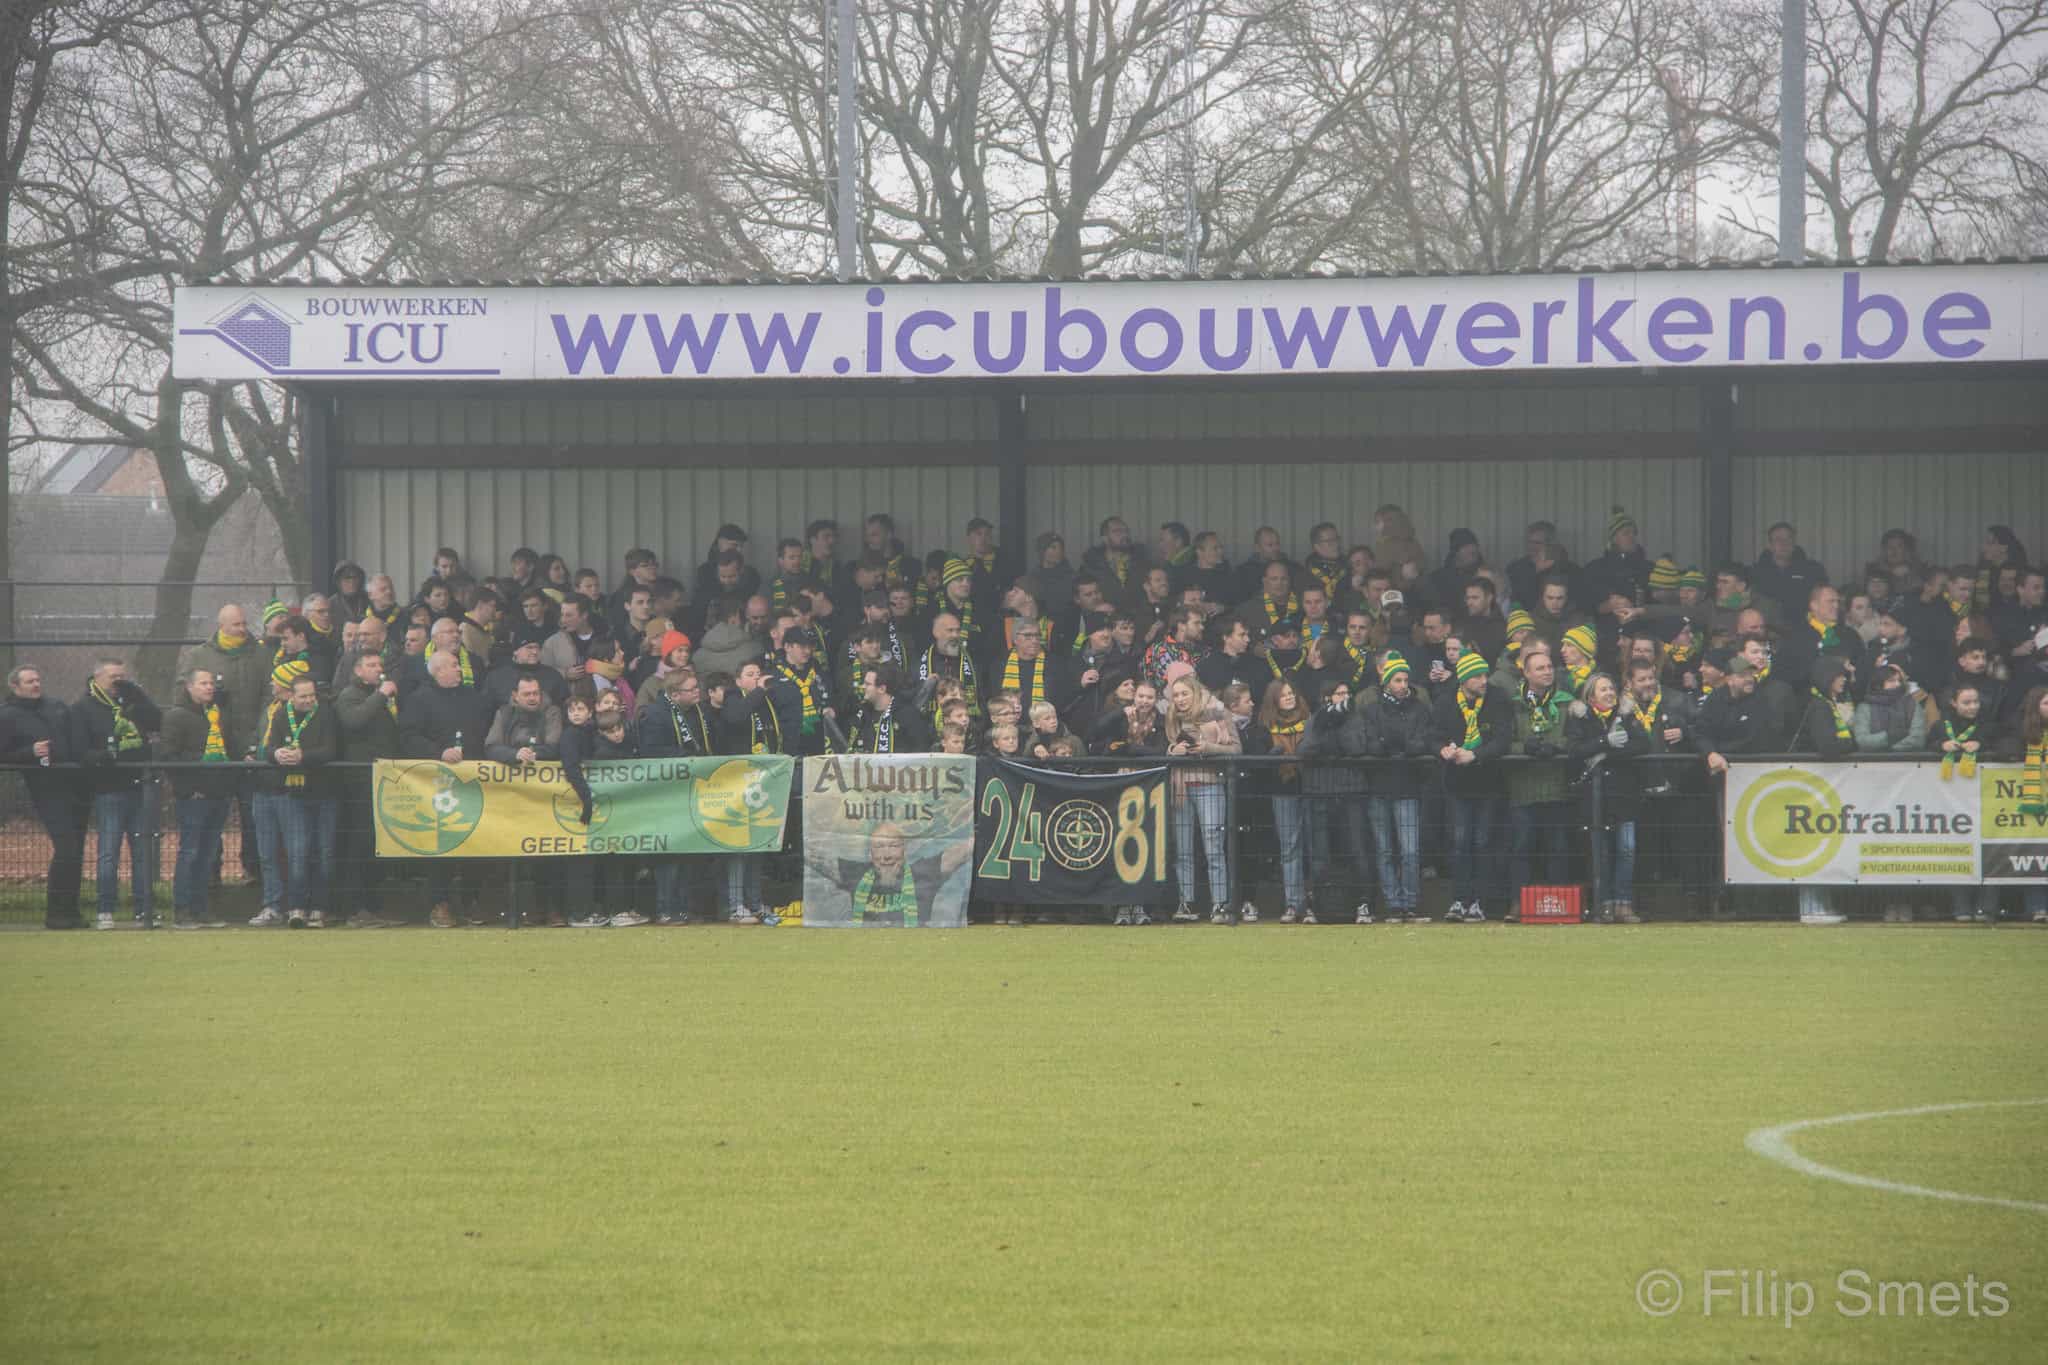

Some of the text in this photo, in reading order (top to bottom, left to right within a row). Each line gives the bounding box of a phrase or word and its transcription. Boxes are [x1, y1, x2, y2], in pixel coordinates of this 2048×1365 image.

[306, 298, 488, 316] BOUWWERKEN
[550, 272, 1992, 376] www.icubouwwerken.be
[344, 323, 448, 363] ICU
[477, 763, 690, 783] SUPPOERSCLUB
[844, 799, 935, 821] with us
[1783, 804, 1973, 835] Rofraline
[1995, 808, 2026, 827] én
[978, 777, 1046, 882] 24
[1114, 782, 1166, 884] 81
[521, 834, 668, 854] GEEL-GROEN
